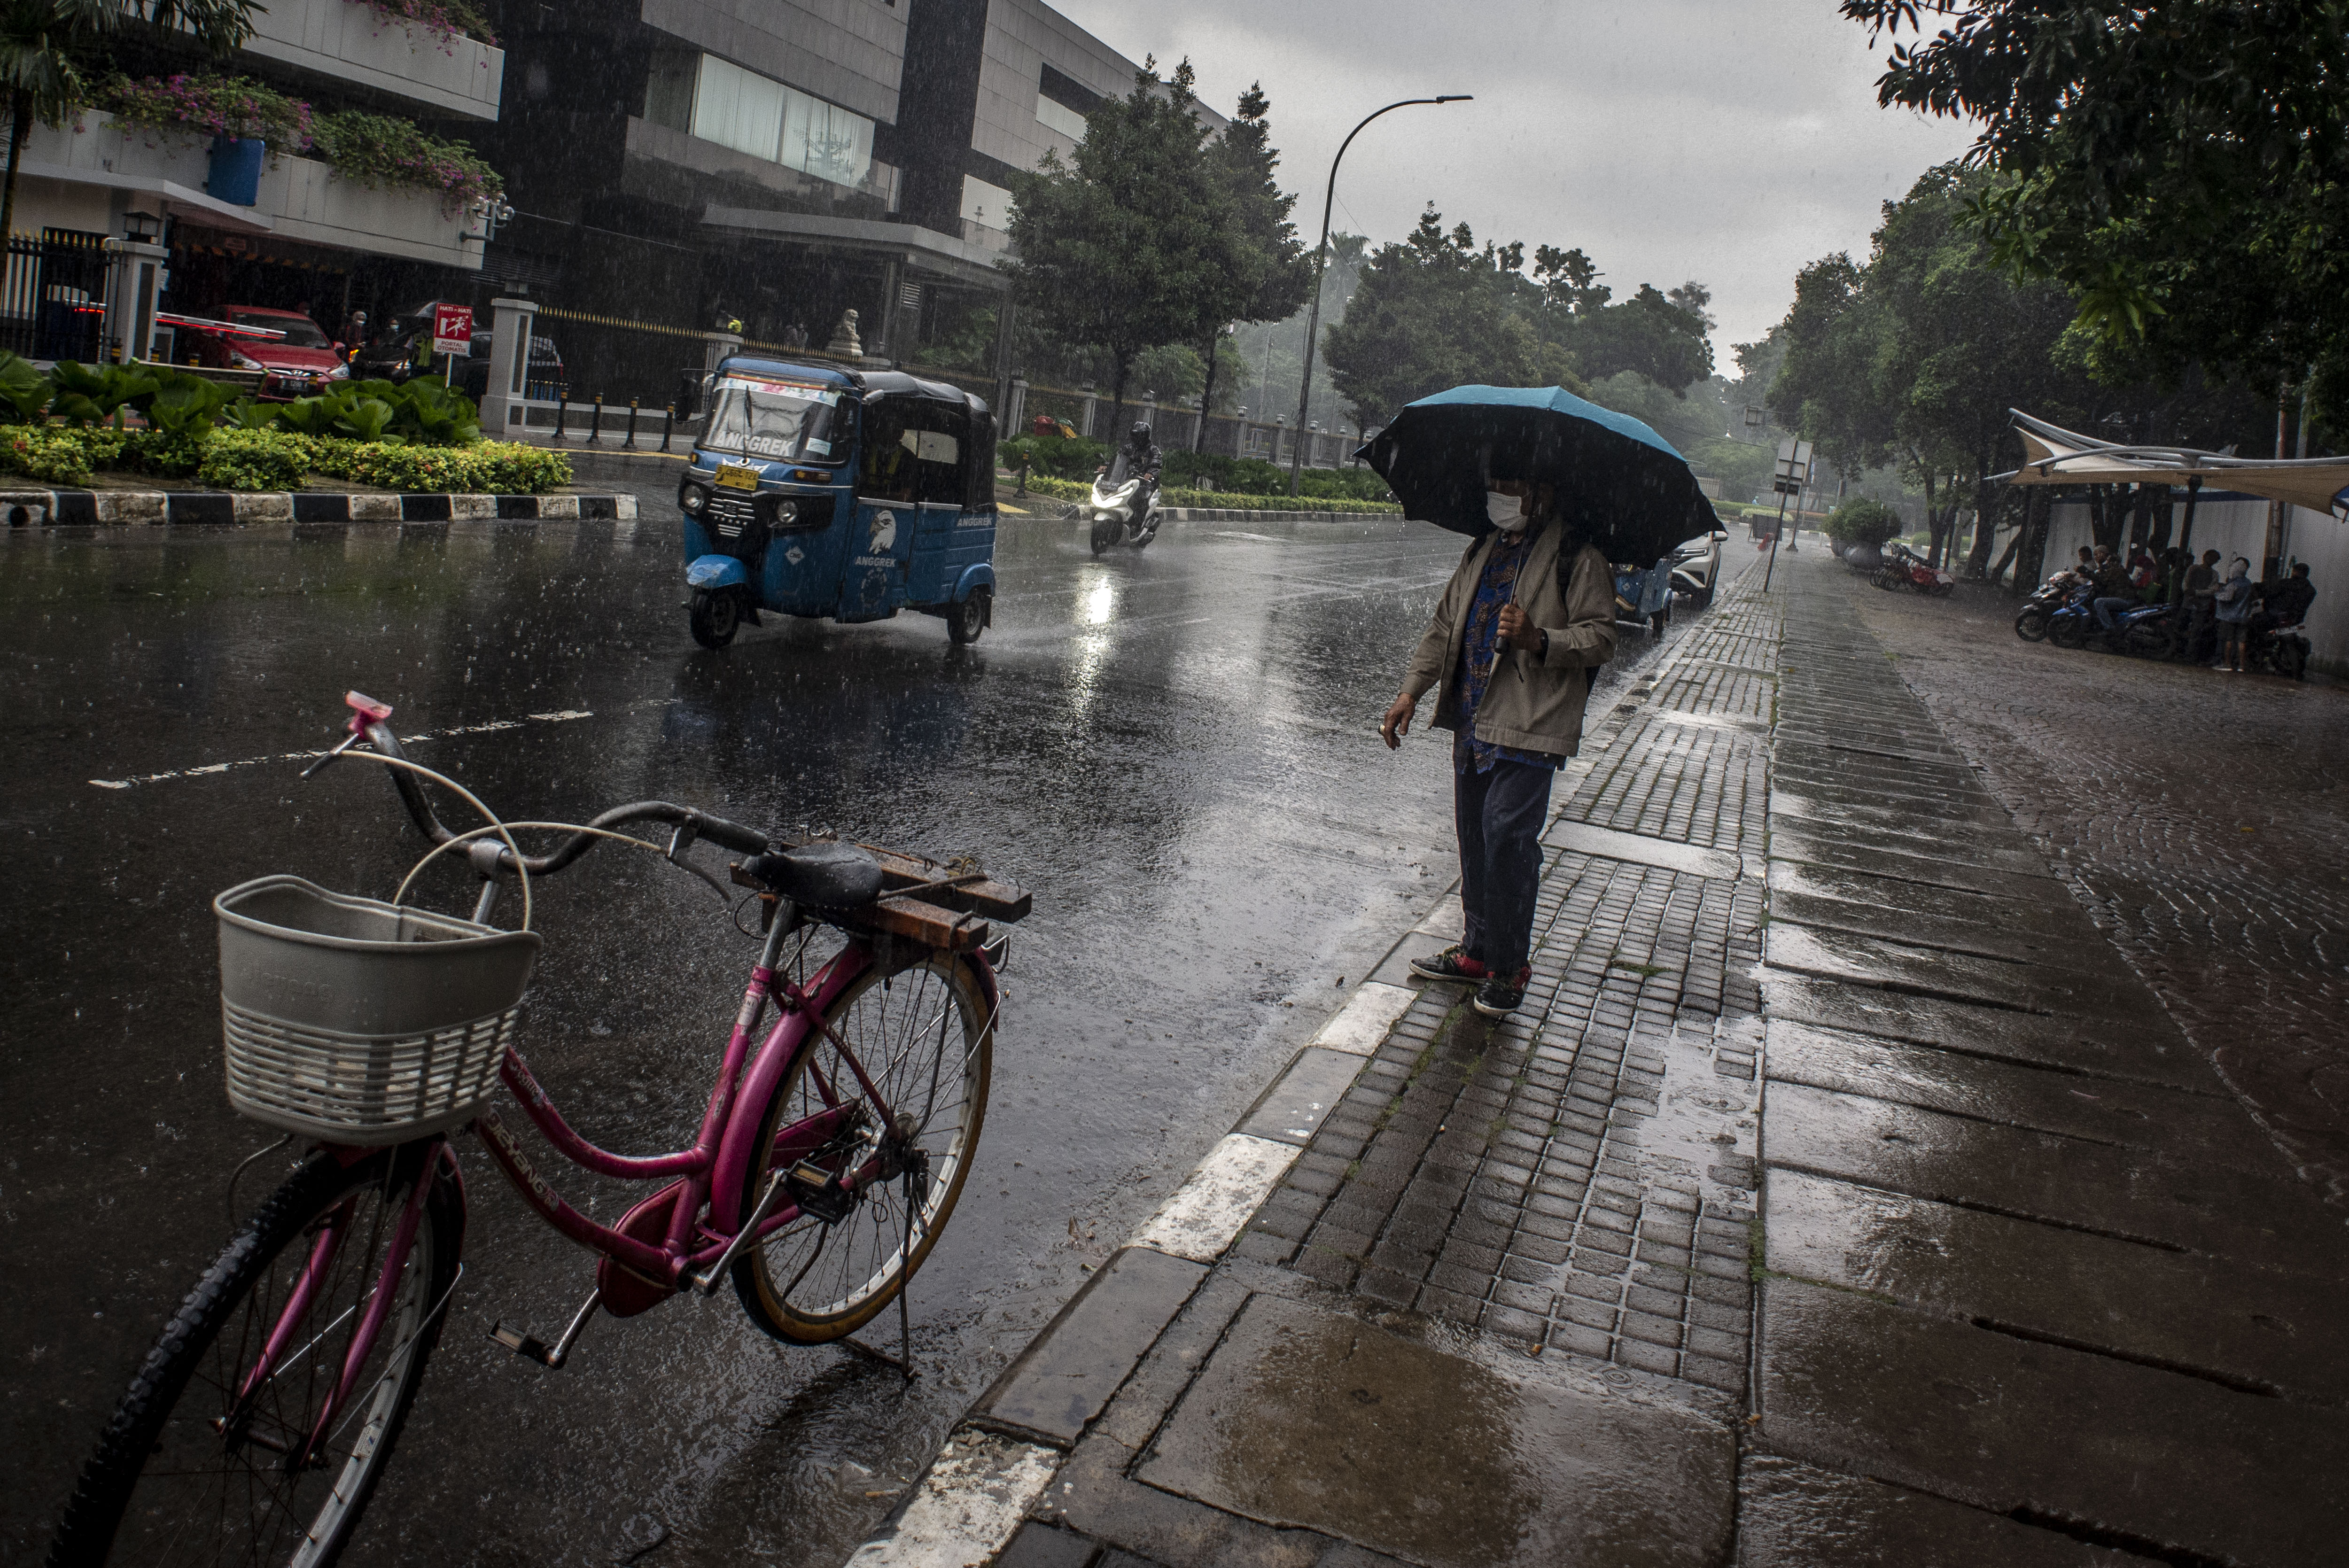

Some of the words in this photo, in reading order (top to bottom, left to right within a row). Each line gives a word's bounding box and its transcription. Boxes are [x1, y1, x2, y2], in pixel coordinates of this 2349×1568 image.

[714, 431, 794, 457] ANGGREK
[957, 517, 992, 526] ANGGREK
[855, 556, 896, 567] ANGGREK
